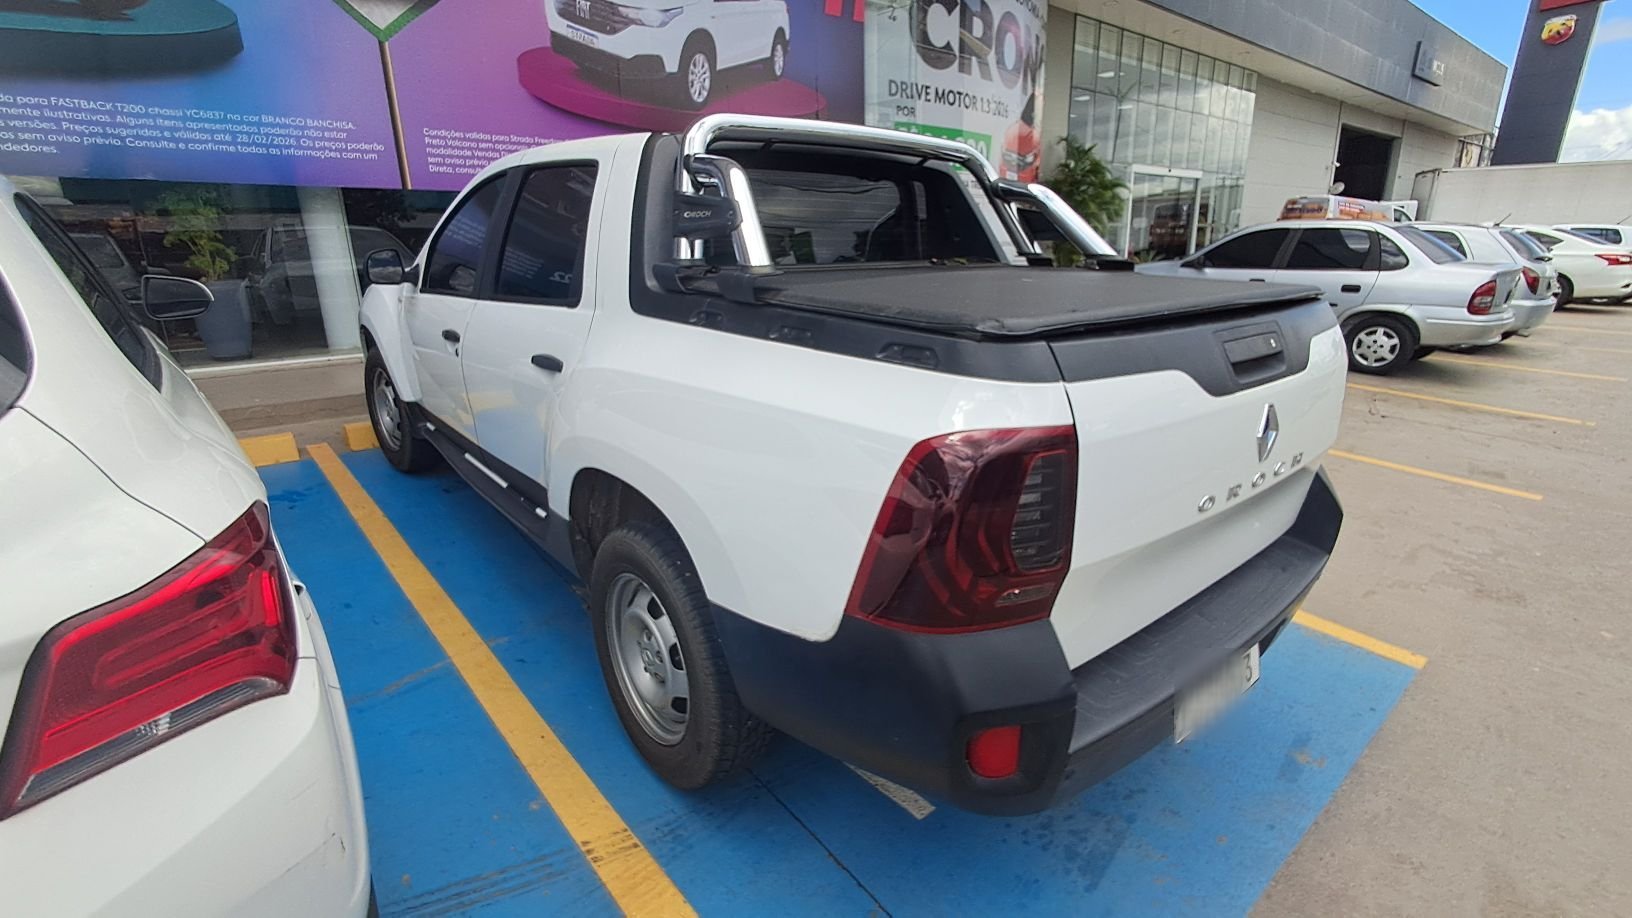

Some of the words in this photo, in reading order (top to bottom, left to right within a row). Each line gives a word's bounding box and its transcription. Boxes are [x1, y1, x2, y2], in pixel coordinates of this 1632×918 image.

[888, 79, 931, 103] DRIVE
[934, 87, 978, 112] MOTOR
[17, 95, 48, 106] para
[51, 97, 114, 110] FASTBACK
[116, 103, 145, 114] T200
[149, 106, 183, 117] chassi
[185, 109, 225, 119] YC6837
[227, 113, 241, 121] na
[243, 114, 260, 122] cor
[261, 115, 305, 126] BRANCO
[896, 104, 916, 118] POR
[8, 118, 59, 130] versões.
[62, 121, 103, 134] Preços
[164, 130, 171, 138] e
[213, 132, 232, 142] até
[237, 133, 298, 146] 28/02/2026.
[300, 138, 314, 147] Os
[315, 140, 346, 151] preços
[347, 141, 385, 152] poderão
[43, 109, 113, 122] ilustrativas.
[116, 114, 155, 127] Alguns
[156, 117, 184, 127] itens
[186, 120, 258, 134] apresentados
[260, 125, 302, 137] poderão
[304, 128, 323, 137] não
[324, 130, 348, 139] estar
[423, 127, 464, 138] Condições
[492, 134, 510, 142] para
[510, 134, 534, 144] Strada
[17, 131, 46, 141] sem
[48, 134, 81, 143] aviso
[83, 135, 124, 146] prévio.
[126, 137, 176, 149] Consulte
[188, 142, 236, 153] confirme
[237, 144, 268, 154] todas
[282, 147, 341, 159] informações
[342, 151, 362, 160] com
[363, 152, 378, 160] um
[424, 137, 446, 145] Preto
[446, 138, 478, 148] Volcano
[426, 147, 472, 156] modalidade
[473, 149, 500, 158] Vendas
[427, 156, 444, 164] sem
[429, 164, 455, 173] Direta,
[1197, 451, 1304, 513] OROCH
